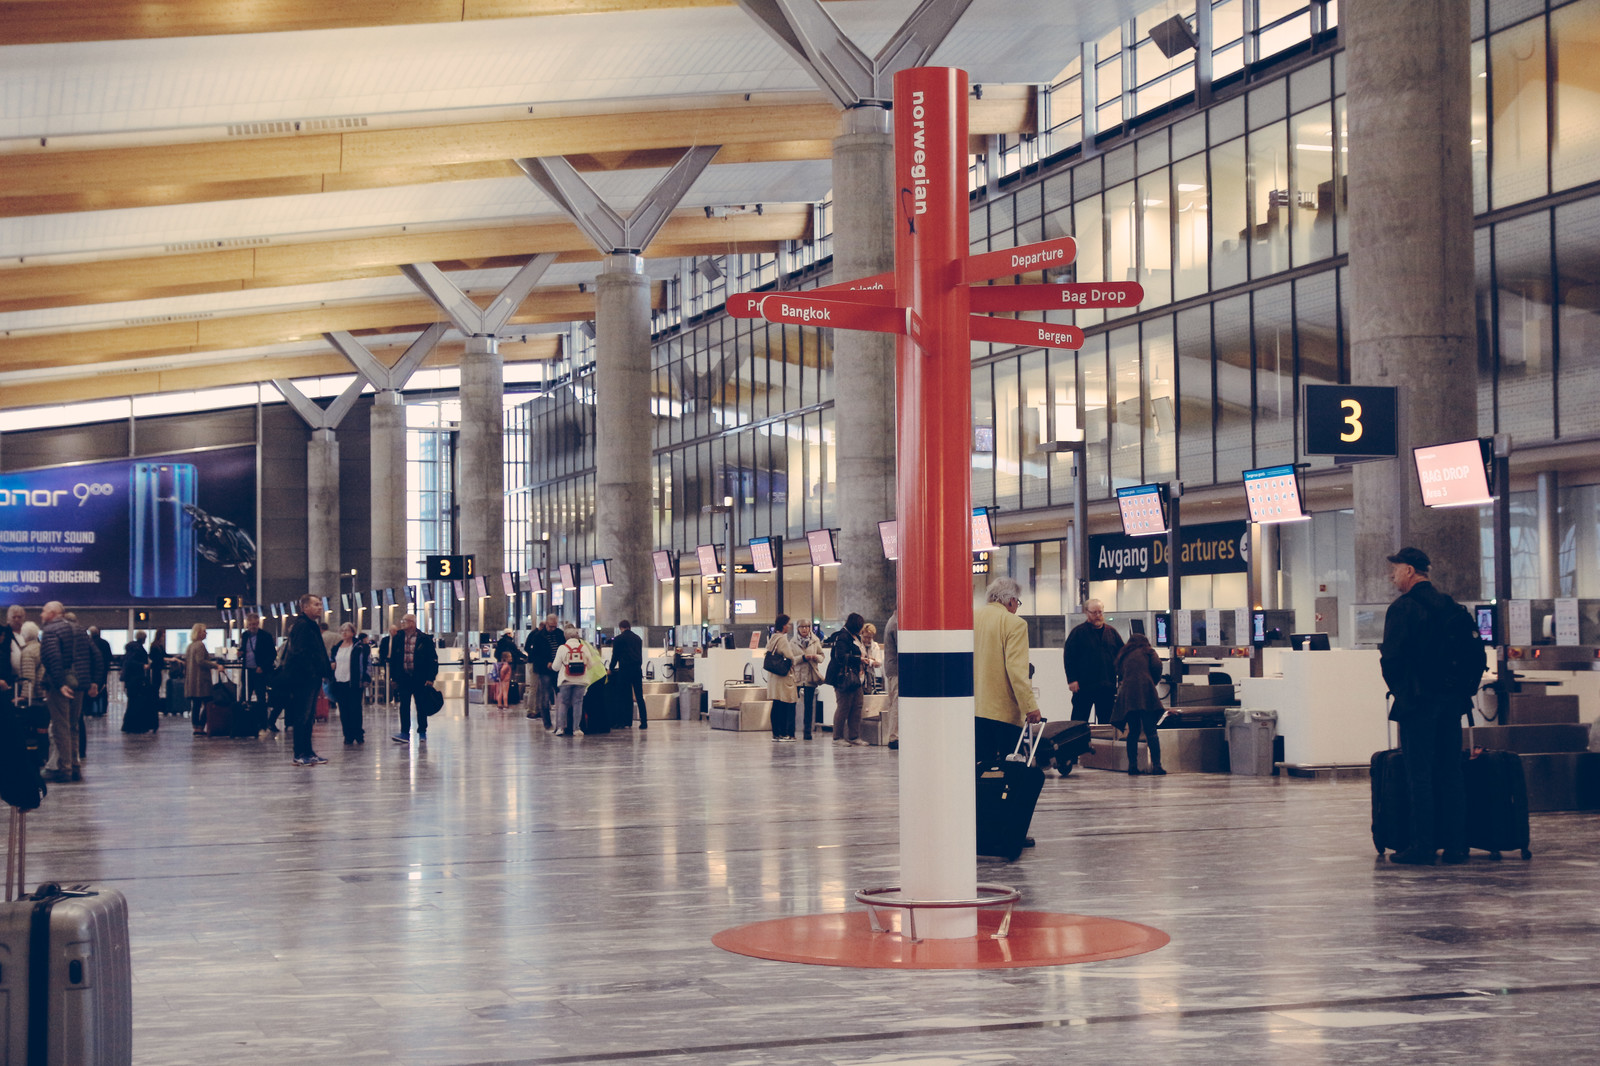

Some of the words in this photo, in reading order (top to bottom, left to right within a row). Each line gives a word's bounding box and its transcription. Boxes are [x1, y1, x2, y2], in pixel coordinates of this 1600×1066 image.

[911, 91, 930, 215] norwegian
[1011, 249, 1064, 268] Departure
[1062, 290, 1087, 304] Bag
[1091, 289, 1126, 303] Drop
[781, 303, 831, 322] Bangkok
[1038, 328, 1073, 345] Bergen
[1340, 399, 1363, 442] 3
[1422, 468, 1443, 484] BAG
[1443, 464, 1470, 481] DROP
[1441, 486, 1448, 497] 3
[30, 531, 63, 543] PURITY
[64, 531, 95, 544] SOUND
[37, 546, 47, 554] by
[1098, 545, 1149, 575] Avgang
[1153, 538, 1236, 565] Deartures
[440, 559, 451, 576] 3
[20, 570, 47, 583] VIDEO
[48, 570, 100, 583] REDIGERING
[11, 584, 40, 592] GoPro
[223, 597, 232, 609] 2
